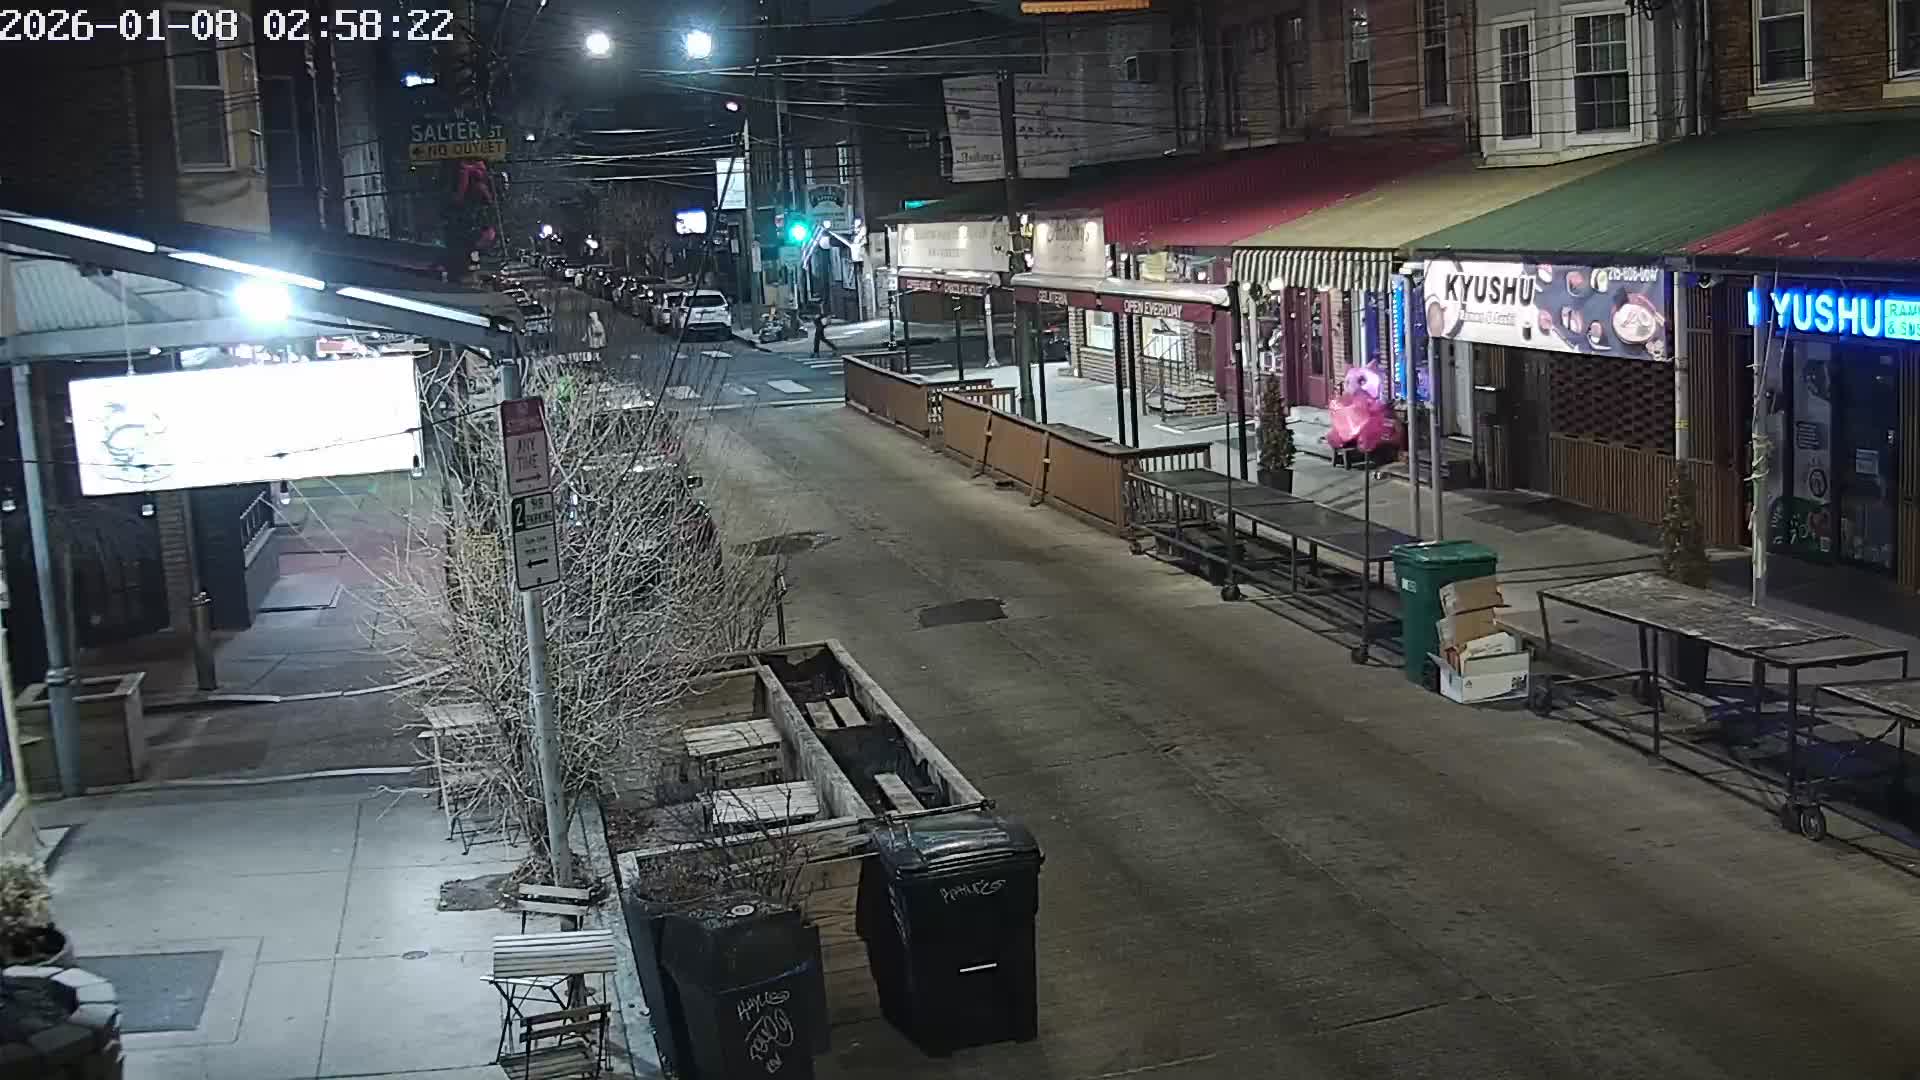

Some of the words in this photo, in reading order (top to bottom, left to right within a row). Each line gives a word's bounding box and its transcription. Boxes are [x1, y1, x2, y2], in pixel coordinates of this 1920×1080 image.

[411, 121, 482, 142] SALTER
[489, 124, 504, 138] ST
[1445, 273, 1534, 306] KYUSHU
[1123, 300, 1142, 315] OPEN
[1143, 301, 1183, 319] EVERYDAY
[515, 503, 524, 526] 2
